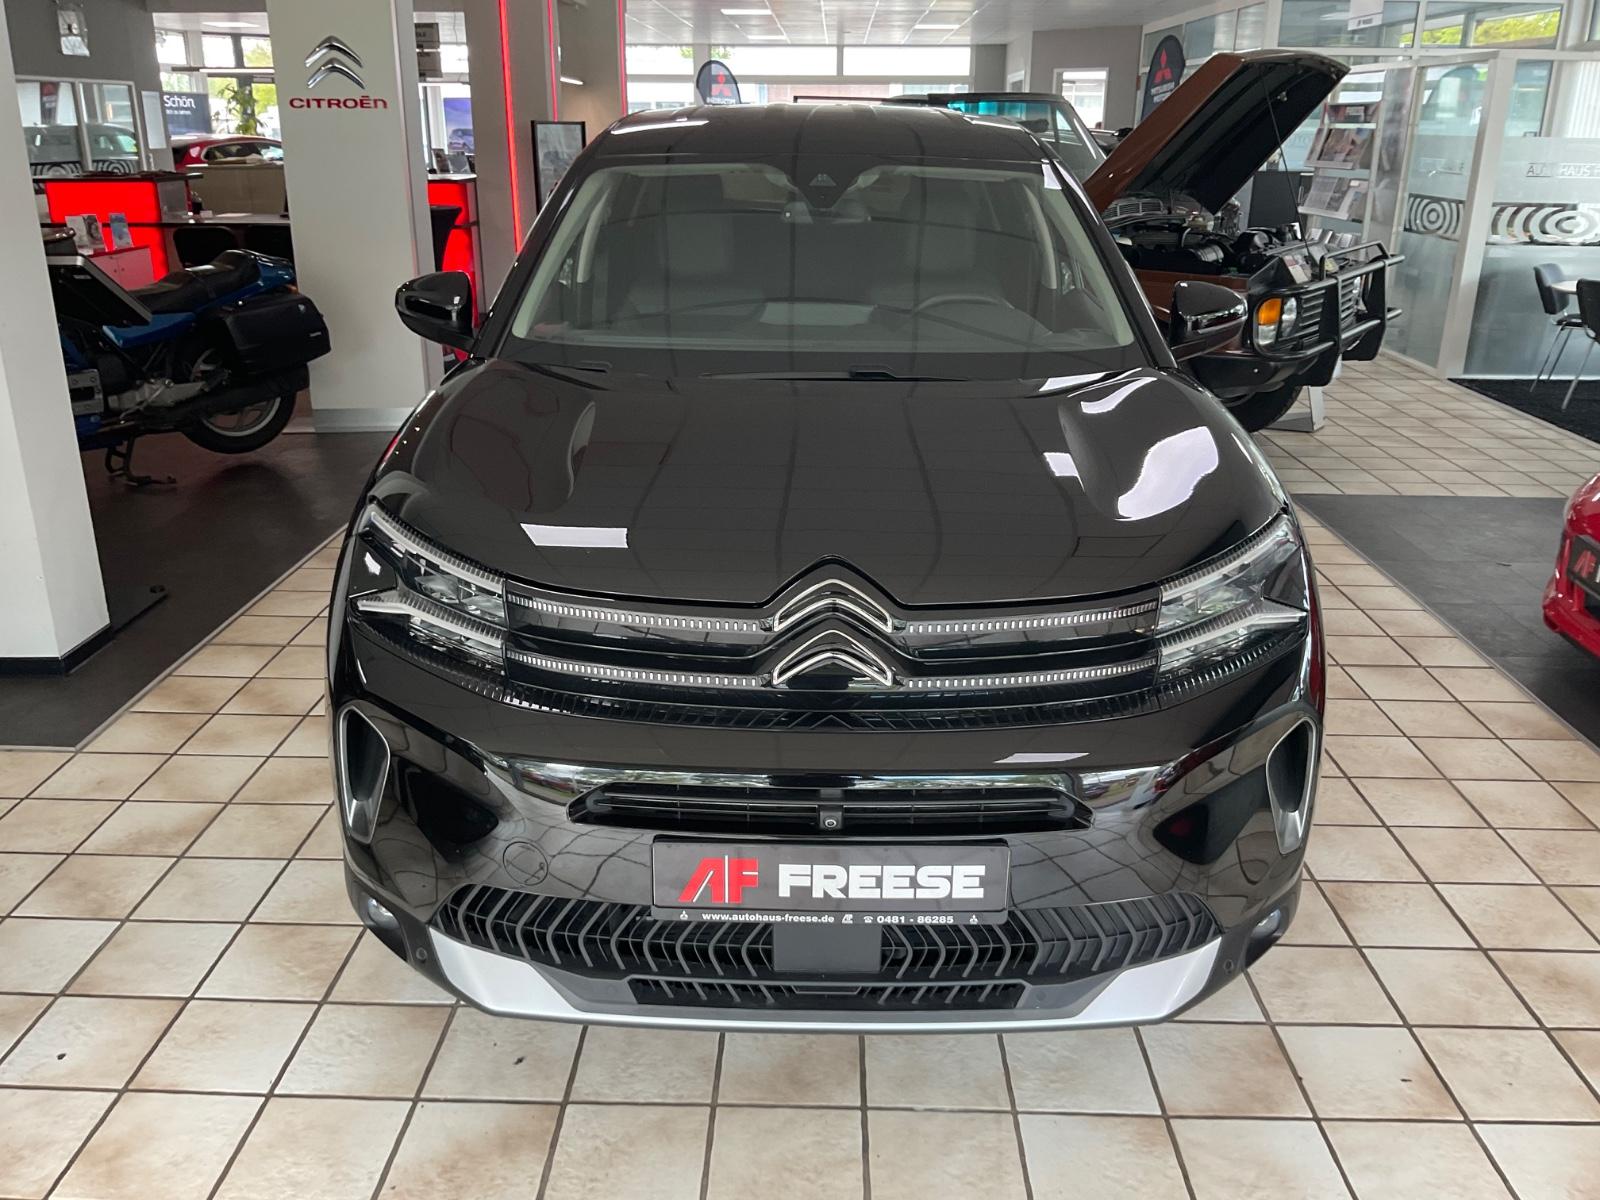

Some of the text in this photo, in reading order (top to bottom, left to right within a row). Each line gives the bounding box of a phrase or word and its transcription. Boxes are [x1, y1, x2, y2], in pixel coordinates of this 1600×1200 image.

[778, 863, 986, 899] FREESE
[702, 912, 835, 923] www.autohaus-freese.de
[877, 915, 905, 924] 0481
[917, 915, 954, 924] 86285
